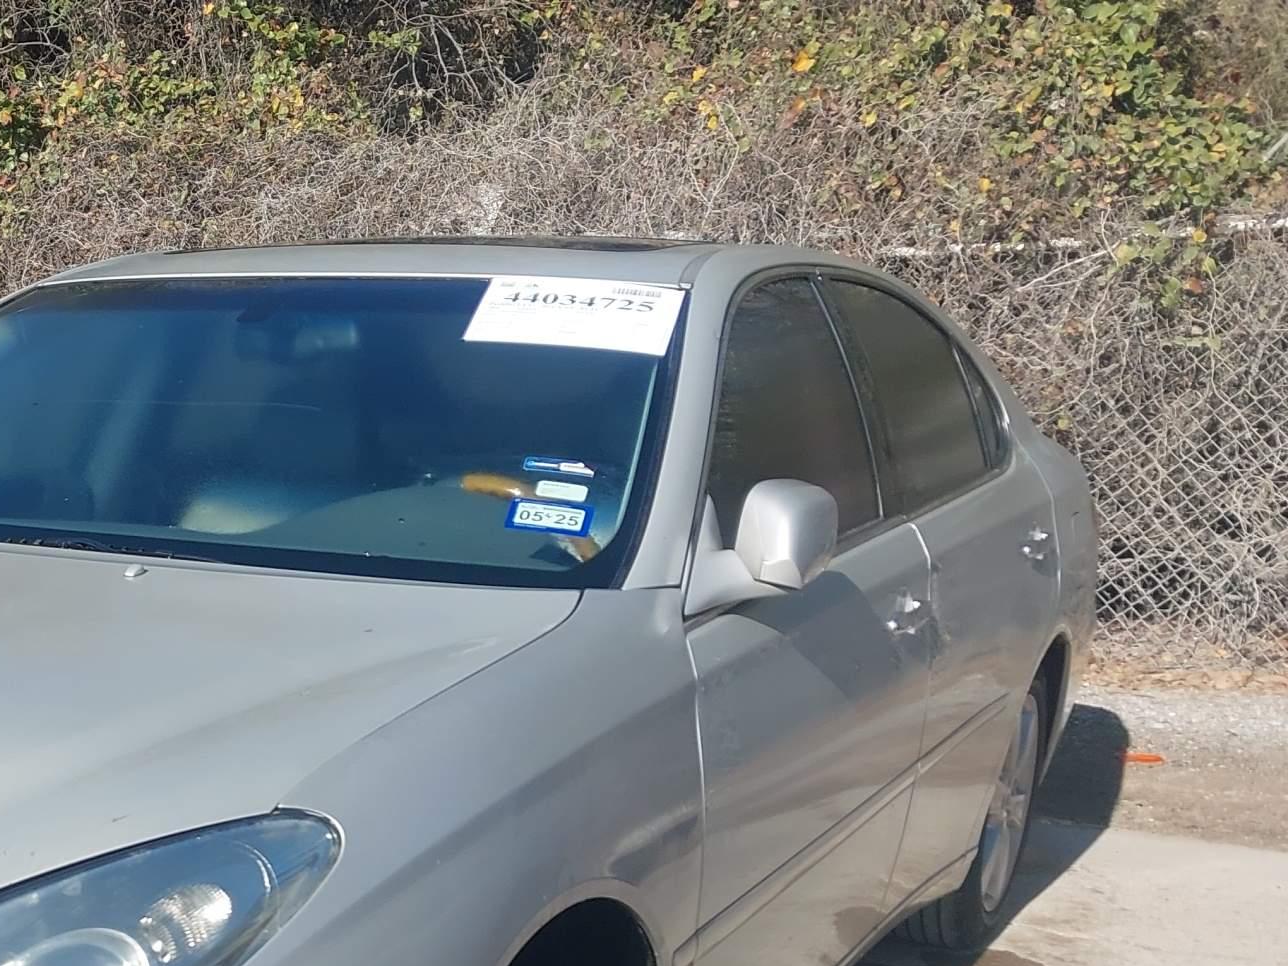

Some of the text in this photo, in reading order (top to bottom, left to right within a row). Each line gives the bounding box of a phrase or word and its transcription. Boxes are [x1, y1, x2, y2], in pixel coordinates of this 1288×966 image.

[503, 291, 655, 313] 44034725
[519, 510, 545, 522] 05
[553, 513, 580, 527] 25
